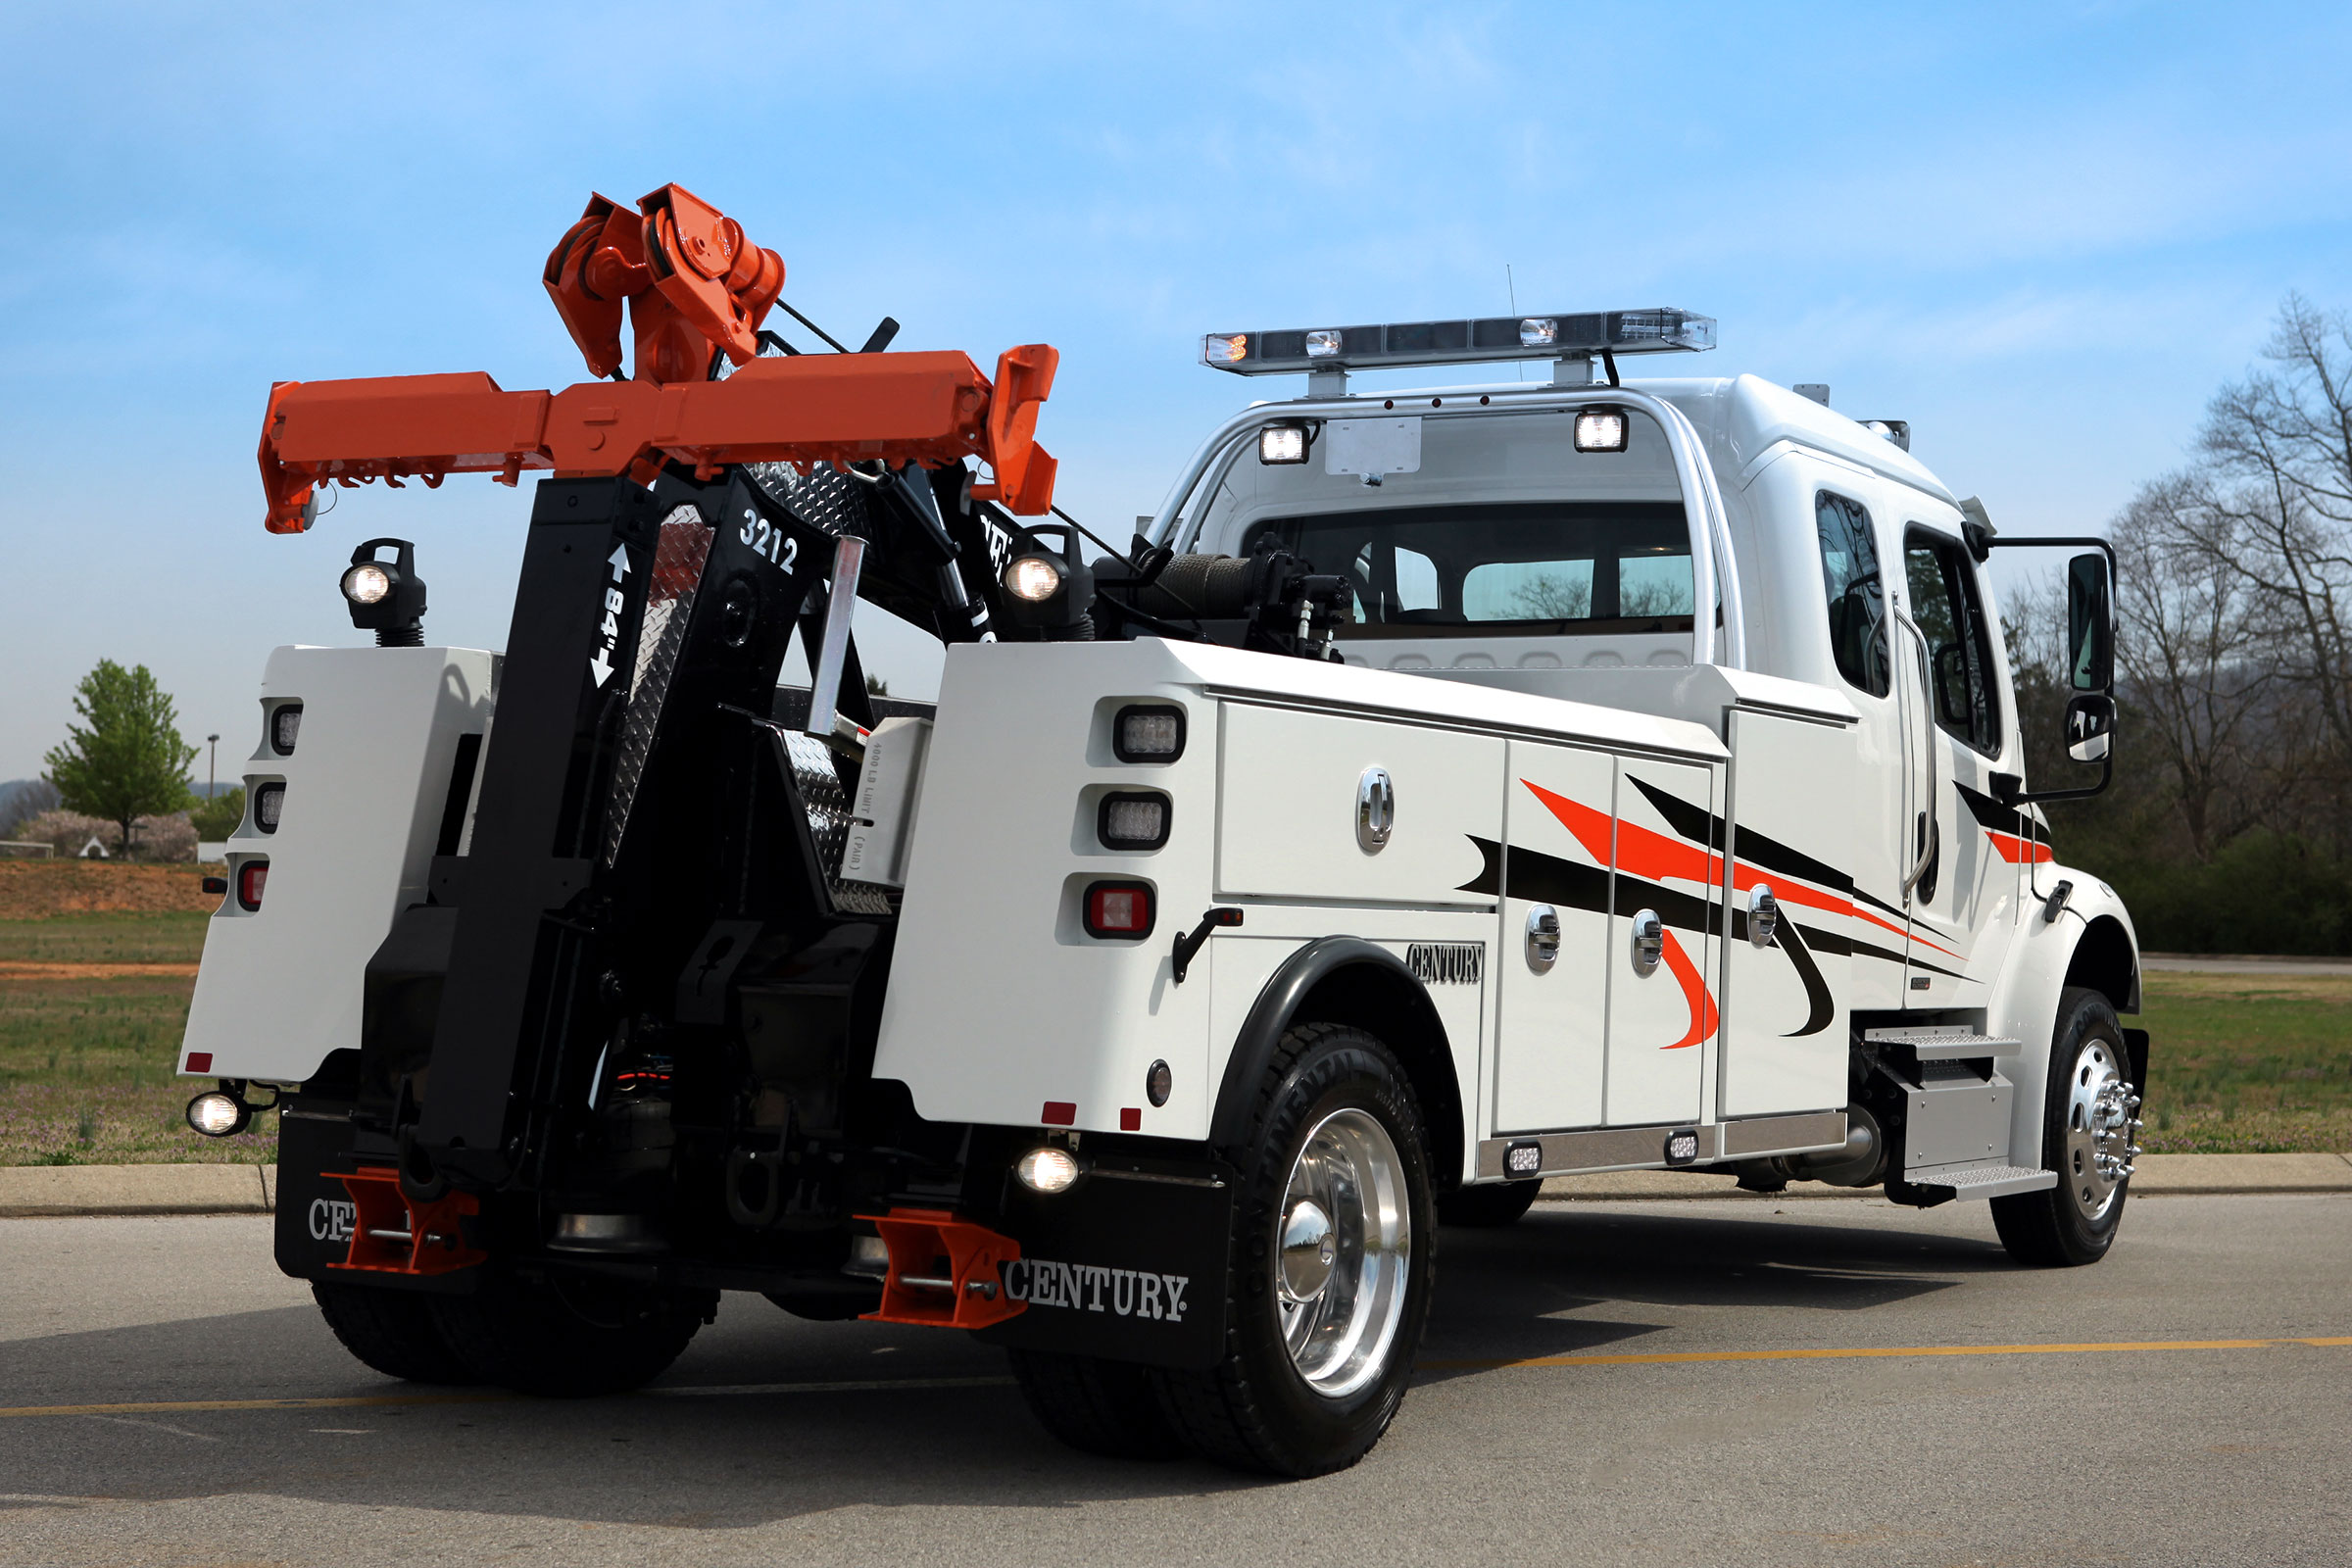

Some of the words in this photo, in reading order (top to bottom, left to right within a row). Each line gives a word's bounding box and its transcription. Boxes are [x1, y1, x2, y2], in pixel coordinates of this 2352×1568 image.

[740, 509, 798, 575] 3212
[861, 787, 874, 813] LIMIT
[1406, 944, 1484, 983] CENTURY
